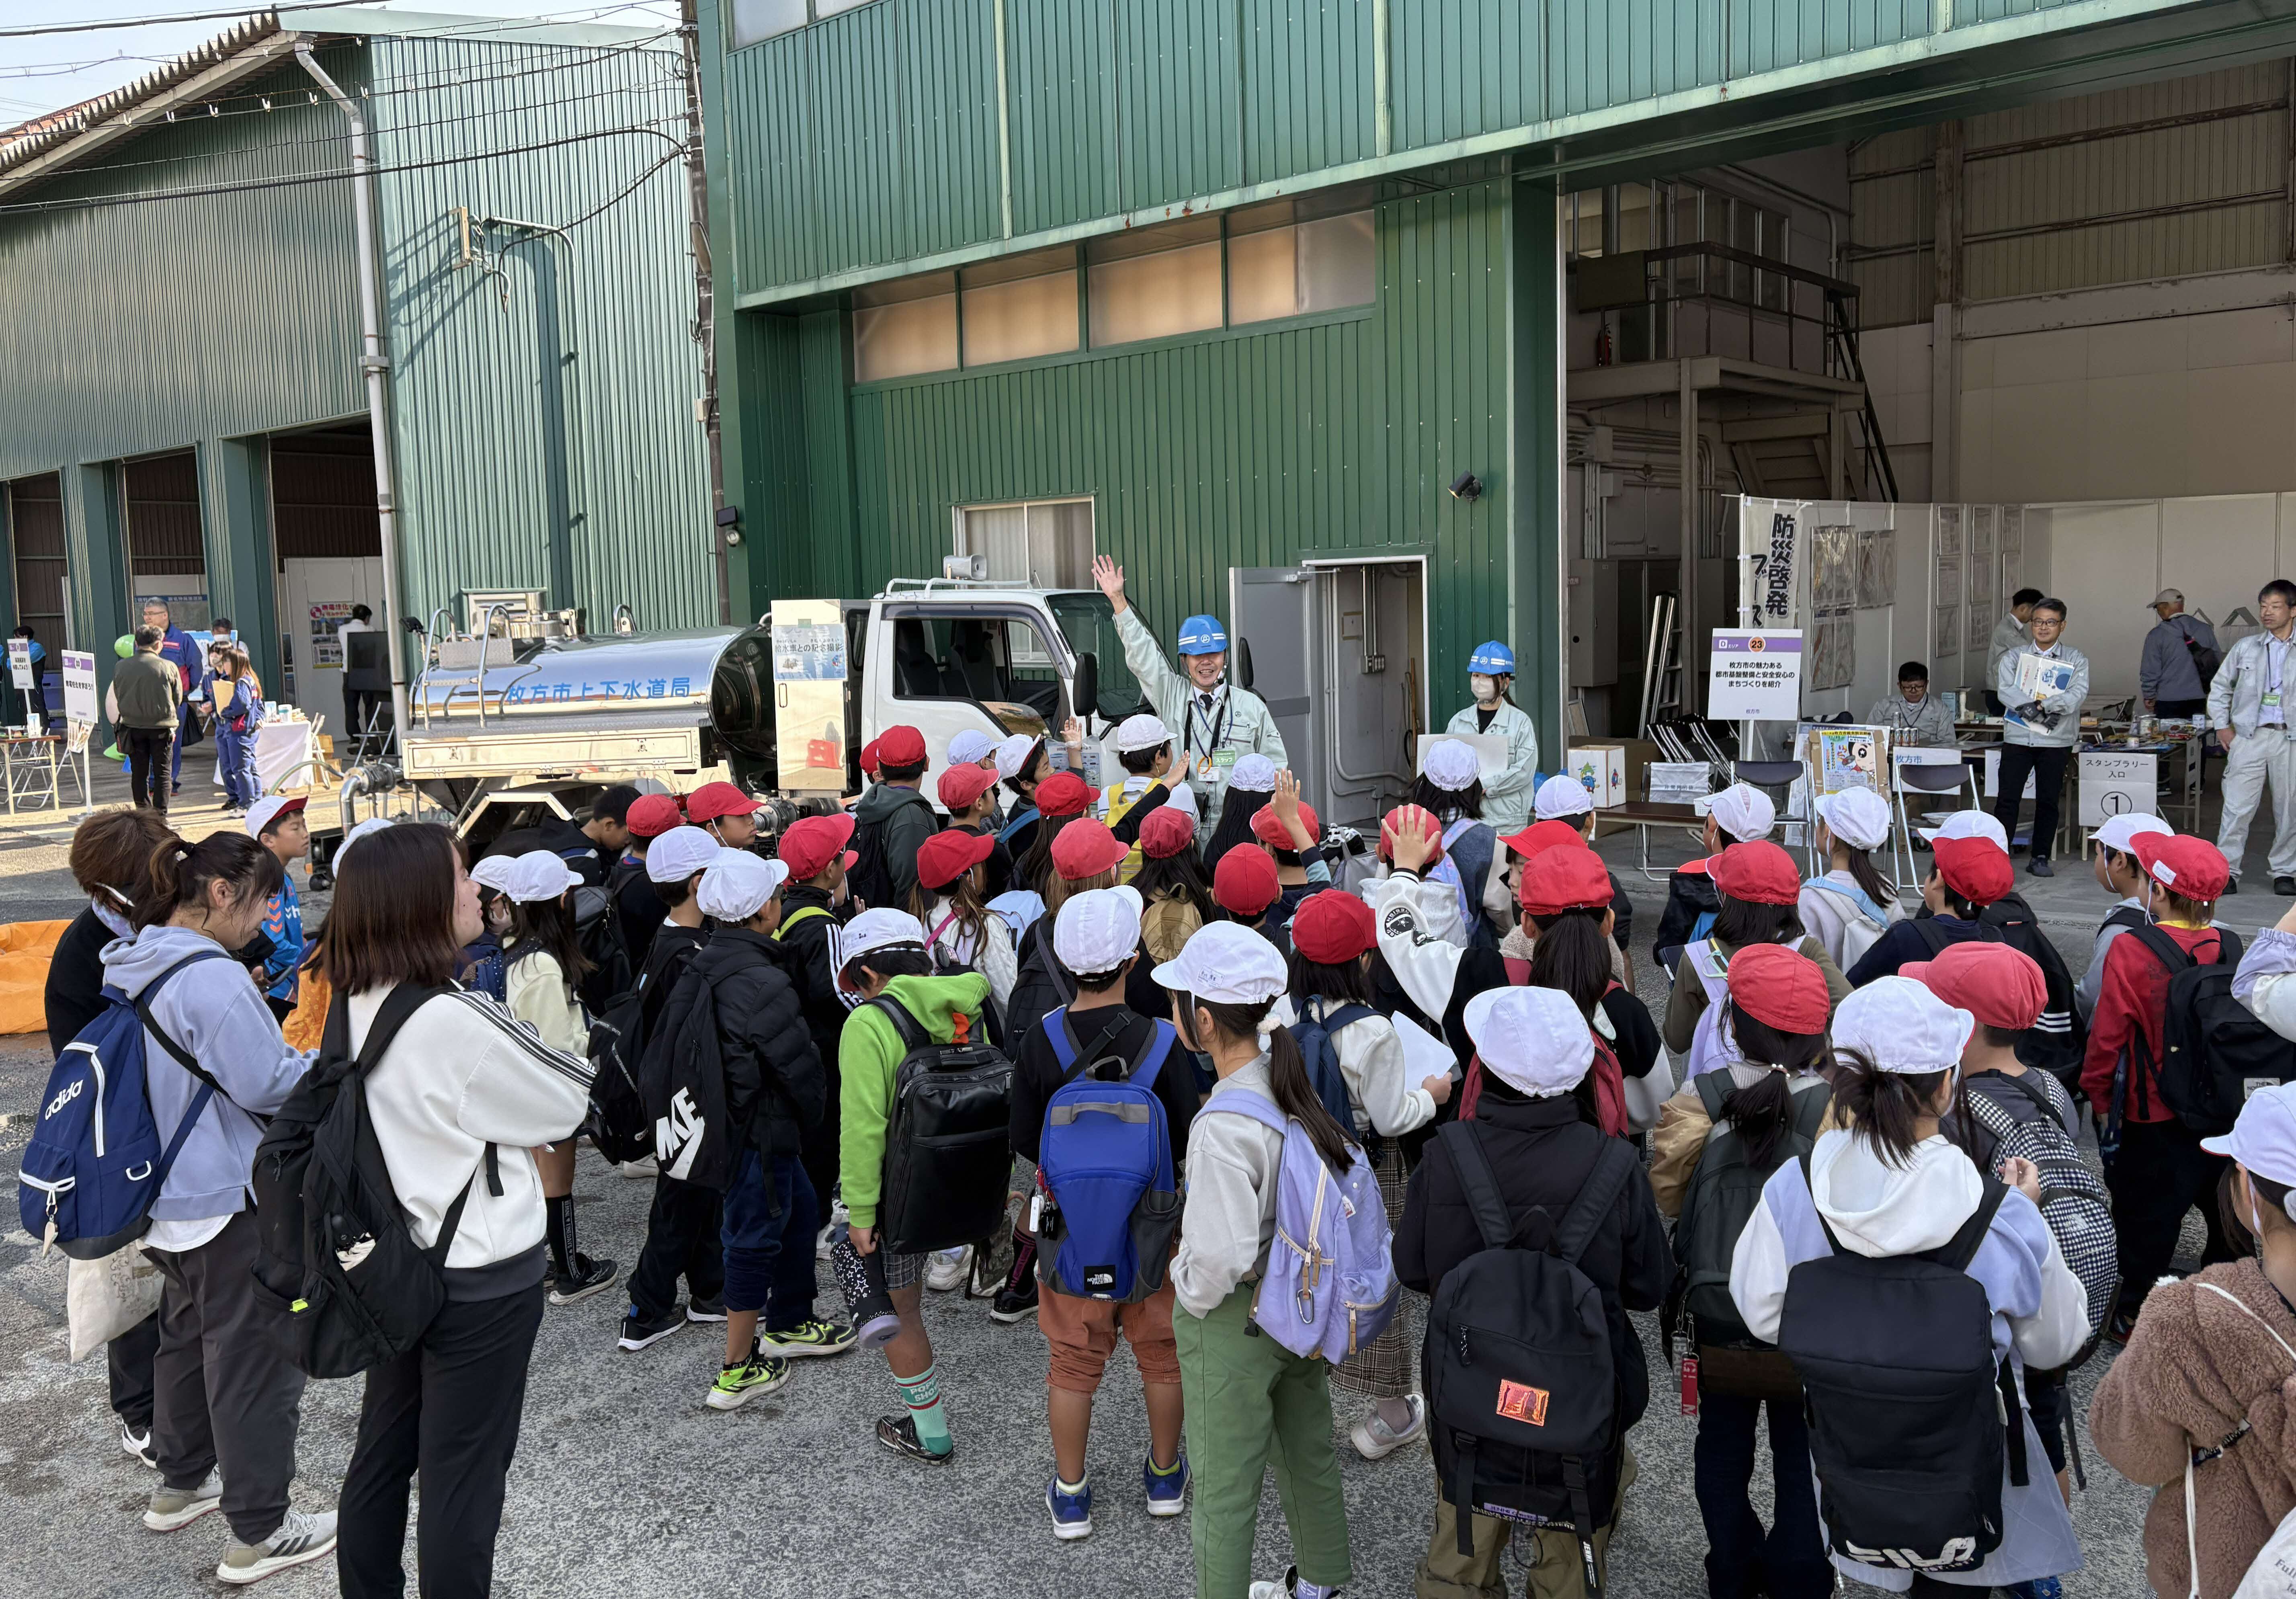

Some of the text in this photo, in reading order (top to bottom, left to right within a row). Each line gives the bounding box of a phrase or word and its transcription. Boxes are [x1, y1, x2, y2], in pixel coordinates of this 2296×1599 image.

[1765, 513, 1795, 616] 防災啓発
[1751, 554, 1767, 627] ブース
[775, 643, 843, 653] 給水車との記念撮影
[1751, 640, 1763, 648] 23
[1728, 680, 1781, 688] まちづくりを紹介
[506, 677, 690, 705] 枚方市上下水道局
[1895, 755, 1922, 764] 枚方市
[2085, 759, 2149, 768] スタンプラリー
[45, 1079, 83, 1120] adida
